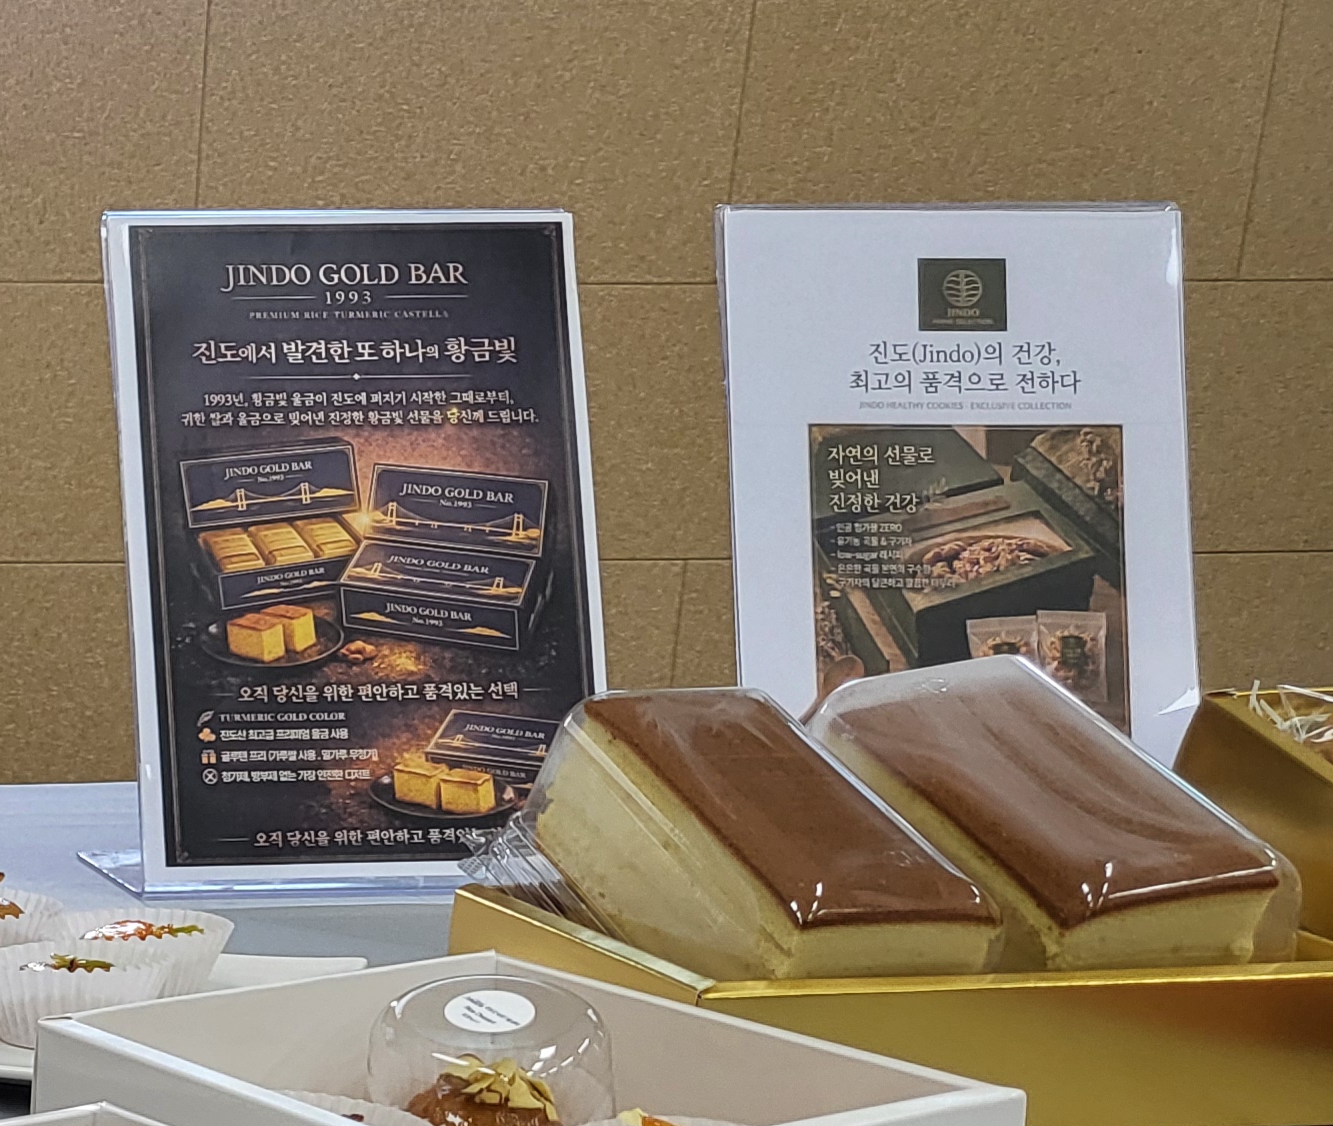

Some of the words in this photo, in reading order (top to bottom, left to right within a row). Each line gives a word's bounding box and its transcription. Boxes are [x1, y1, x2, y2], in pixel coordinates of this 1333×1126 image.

[220, 263, 312, 292] JINDO
[318, 263, 400, 286] GOLD
[408, 262, 469, 285] BAR
[324, 290, 373, 305] 1993
[191, 339, 277, 365] 진도에서
[281, 338, 353, 364] 발견한
[354, 340, 379, 362] 또
[379, 339, 440, 364] 하나의
[443, 336, 518, 364] 황금빛
[869, 340, 1002, 366] 진도(Jindo)의
[1011, 341, 1061, 366] 건강,
[849, 369, 912, 394] 최고의
[920, 369, 1009, 395] 품격으로
[1015, 369, 1082, 395] 전하다
[330, 390, 367, 406] 진도에
[409, 389, 447, 406] 시작한
[886, 401, 924, 410] HEALTHY
[926, 401, 964, 410] COOKIES
[1017, 401, 1072, 410] COLLECTION
[181, 411, 206, 427] 귀한
[327, 409, 365, 426] 진정한
[406, 409, 444, 425] 선물을
[445, 408, 484, 424] 당신께
[486, 408, 540, 424] 드립니다.
[827, 444, 879, 466] 자연의
[884, 444, 935, 466] 선물로
[224, 466, 258, 481] JINDO
[258, 463, 290, 476] GOLD
[828, 468, 880, 489] 빚어낸
[399, 482, 444, 498] JINDO
[445, 486, 486, 501] GOLD
[486, 490, 514, 504] BAR
[829, 492, 882, 513] 진정한
[885, 492, 921, 513] 건강
[237, 684, 269, 704] 오직
[272, 684, 319, 703] 당신을
[323, 683, 354, 703] 위한
[357, 682, 420, 702] 편안하고
[422, 681, 485, 701] 품격있는
[488, 681, 519, 699] 선택
[277, 712, 307, 722] GOLD
[308, 711, 346, 722] COLOR
[253, 831, 282, 848] 오직
[286, 829, 330, 847] 당신을
[333, 829, 362, 846] 위한
[365, 828, 425, 845] 편안하고
